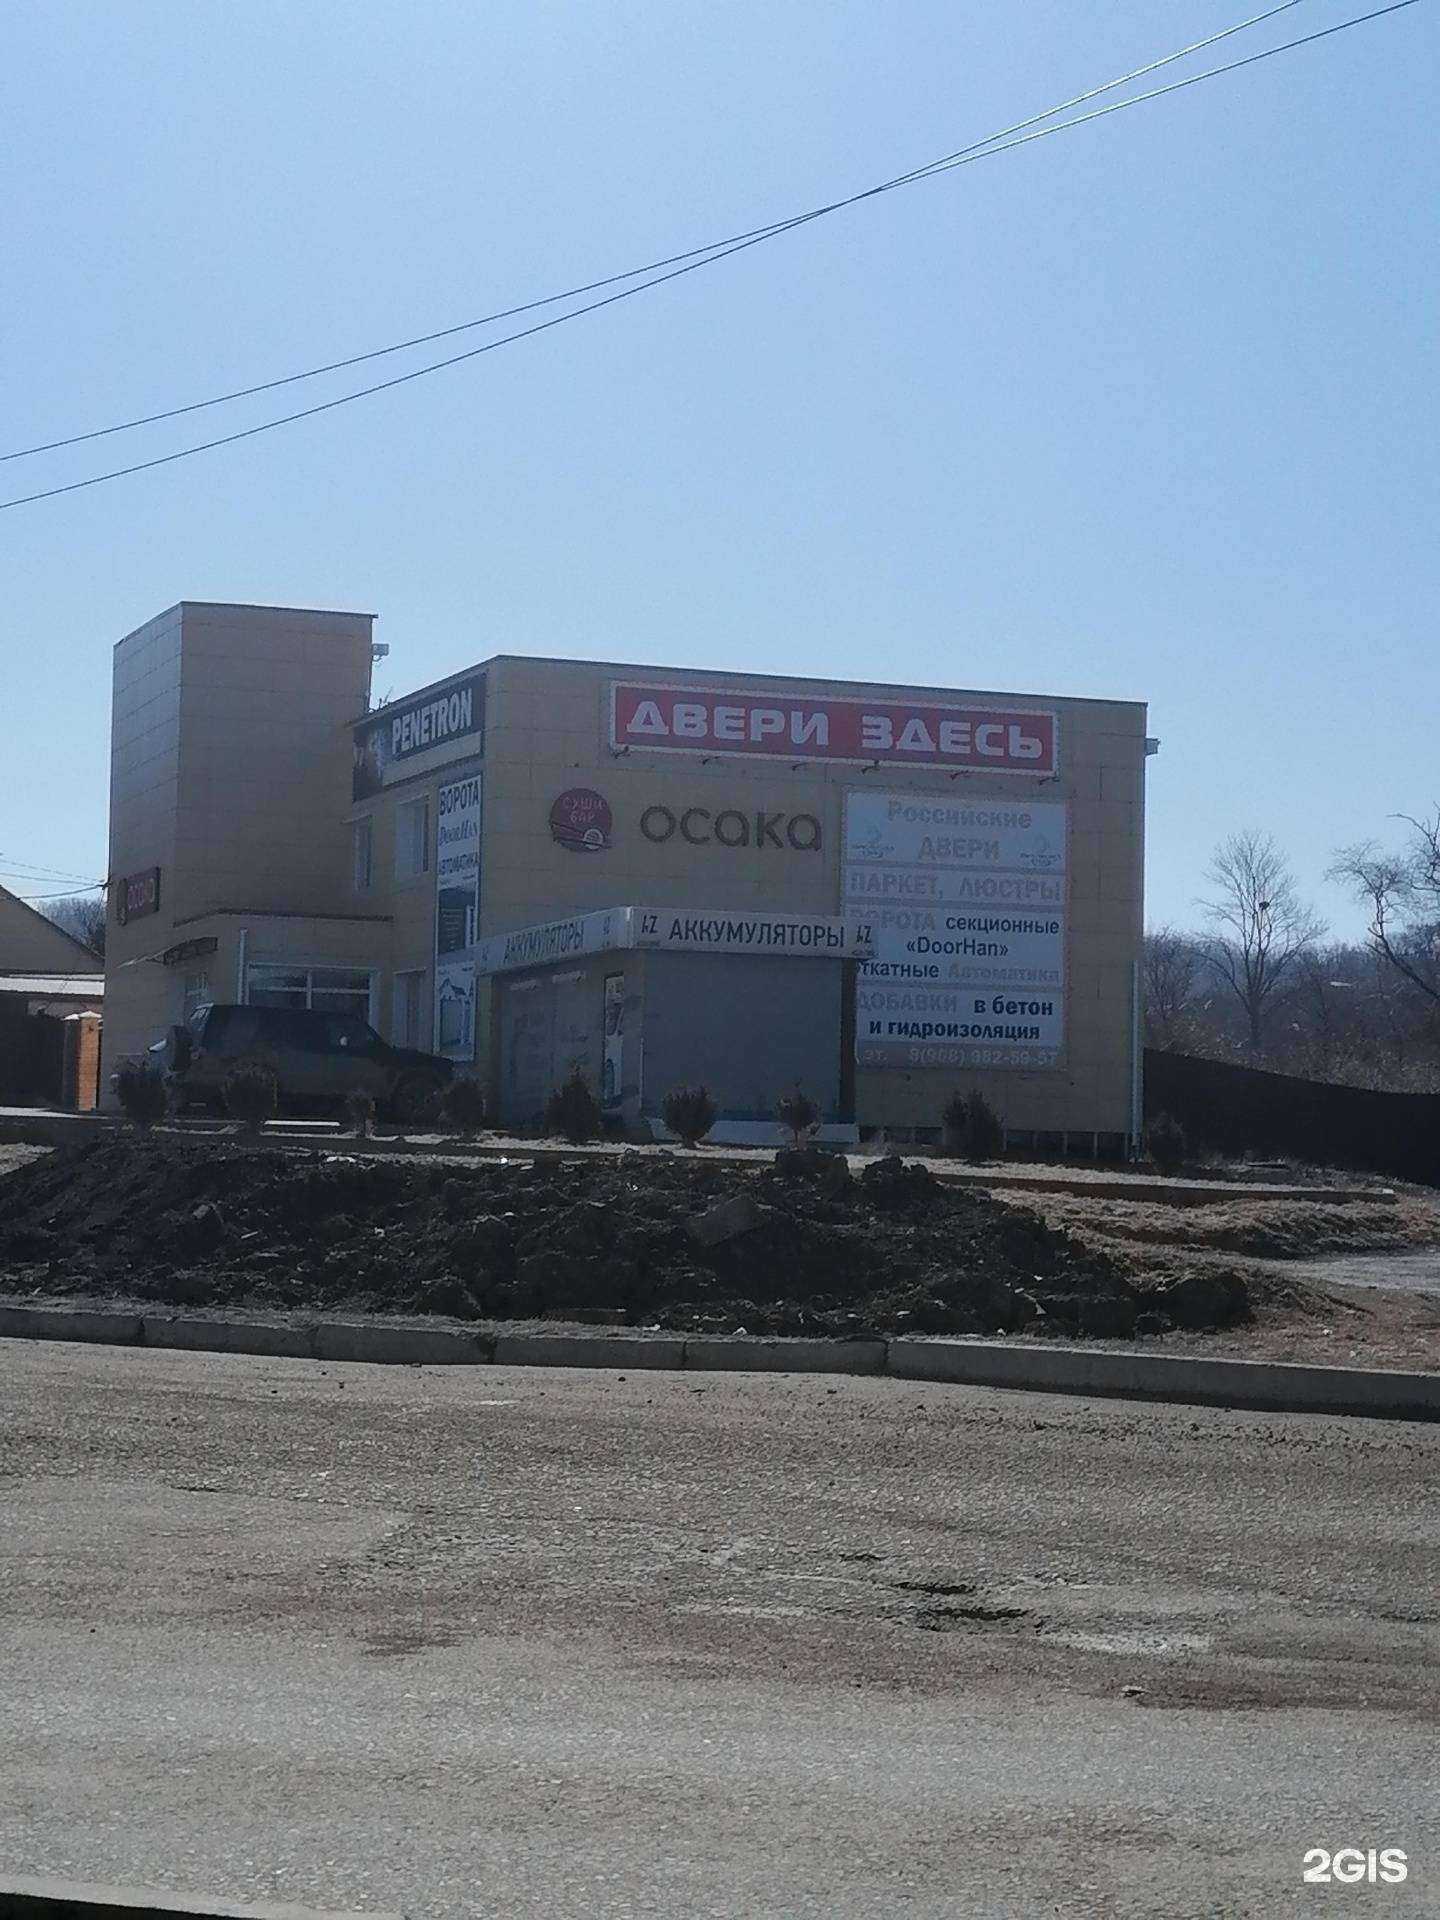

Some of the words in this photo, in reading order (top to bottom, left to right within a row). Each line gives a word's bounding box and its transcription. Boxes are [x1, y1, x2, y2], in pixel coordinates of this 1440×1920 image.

[391, 688, 472, 755] PENETRON
[626, 701, 829, 746] ДВЕРИ
[861, 715, 1043, 759] ЗДЕСЬ
[440, 780, 479, 816] ВОРОТА
[918, 836, 1000, 861] ДВЕРИ
[959, 876, 1061, 902] ЛЮСТРЫ
[669, 918, 845, 948] АККУМУЛЯТОРЫ
[946, 916, 1059, 935] секционные
[907, 937, 1008, 956] «DoorHan»
[857, 959, 939, 978] ткатные
[973, 999, 986, 1014] в
[992, 995, 1053, 1016] бетон
[869, 1021, 881, 1035] и
[888, 1021, 1040, 1042] гидроизоляция
